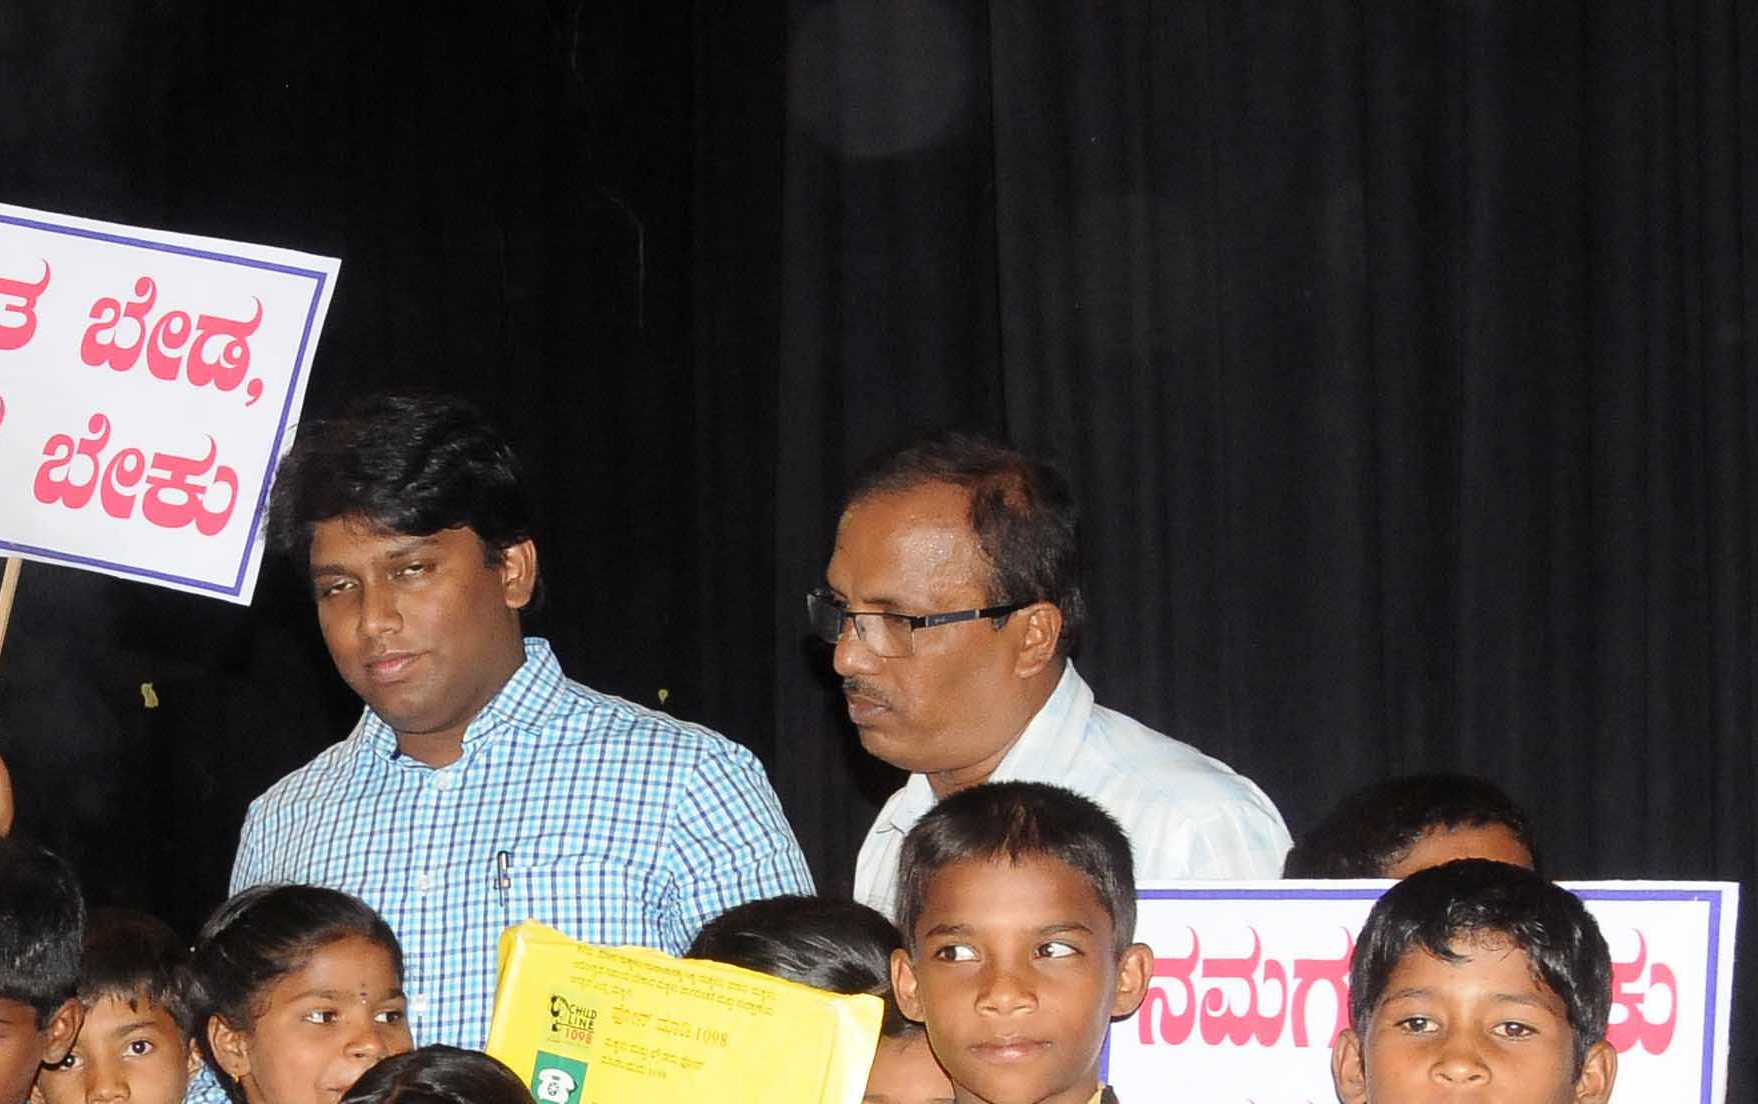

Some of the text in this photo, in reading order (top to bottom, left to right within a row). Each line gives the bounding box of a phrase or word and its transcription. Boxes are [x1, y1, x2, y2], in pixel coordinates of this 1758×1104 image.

[80, 276, 265, 407] ಬೇಡ,
[33, 412, 239, 536] ಬೇಕು
[565, 1027, 593, 1045] 1098
